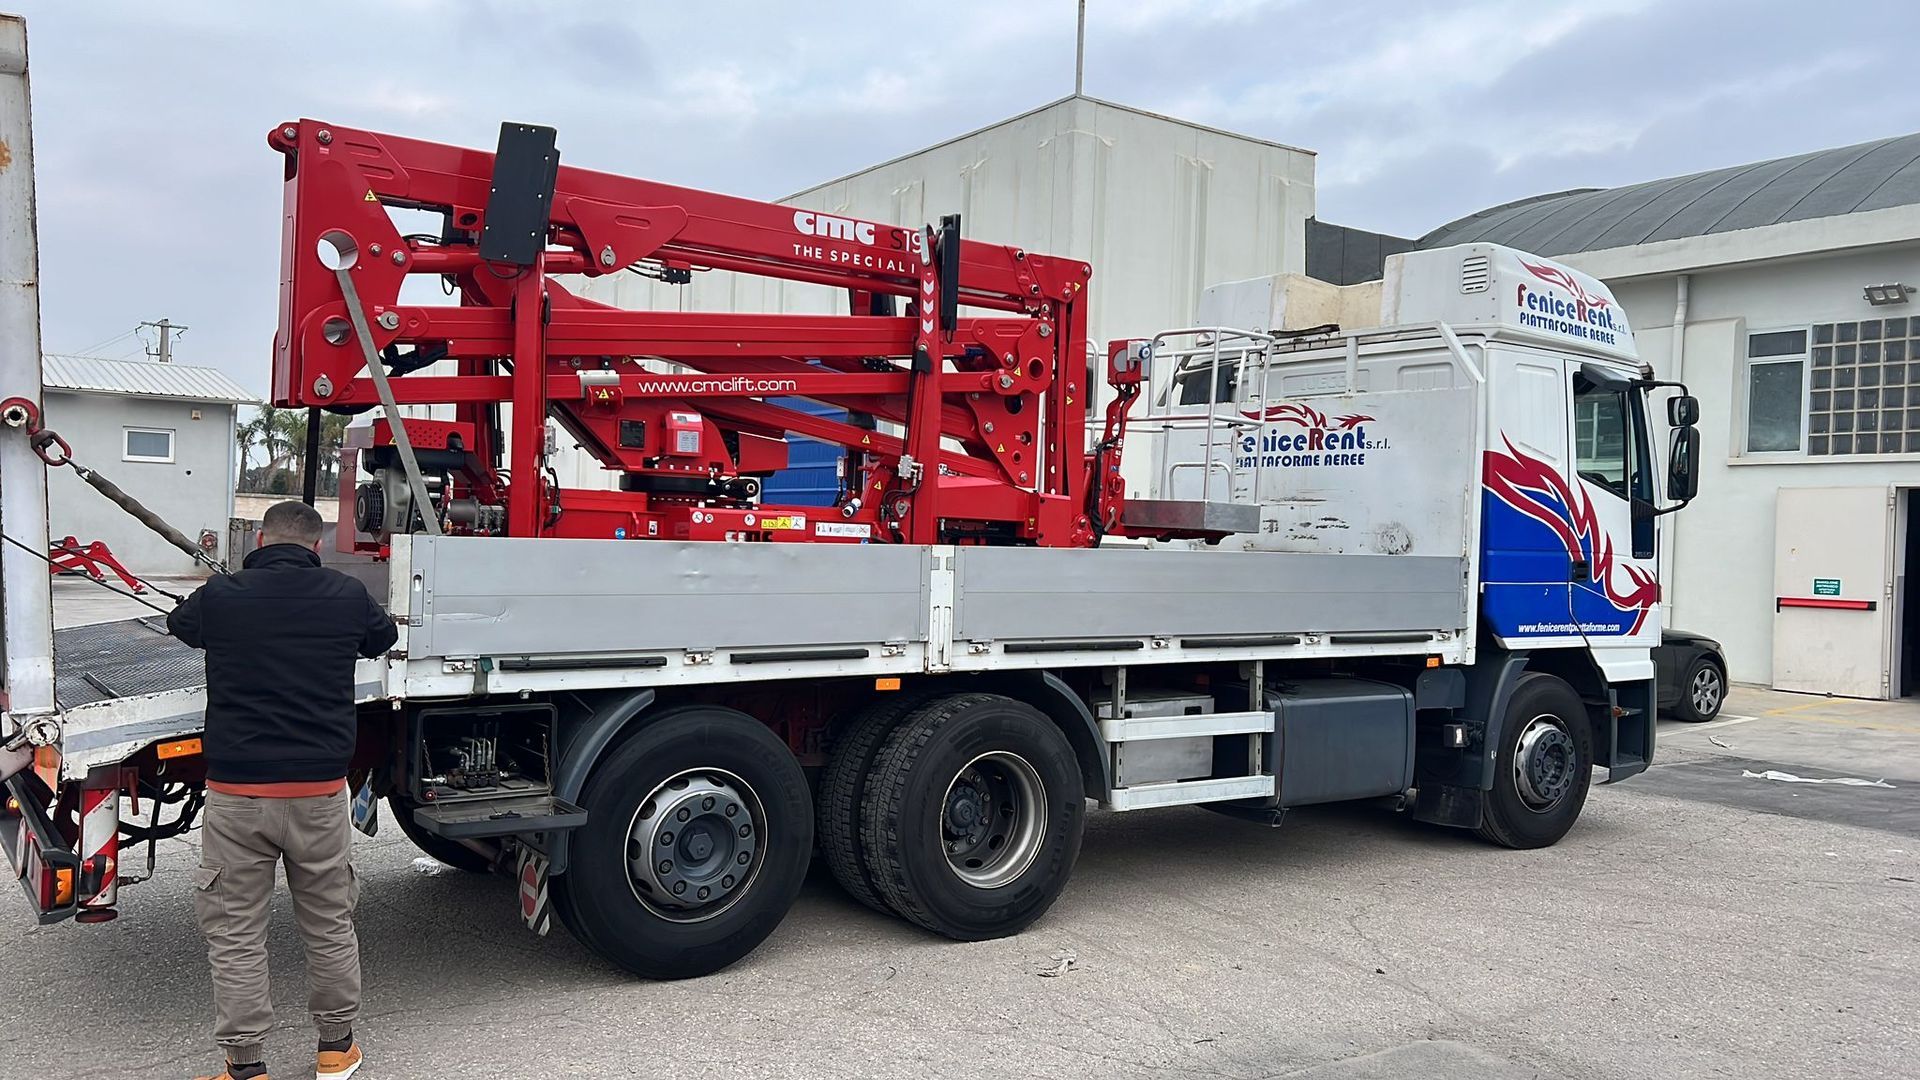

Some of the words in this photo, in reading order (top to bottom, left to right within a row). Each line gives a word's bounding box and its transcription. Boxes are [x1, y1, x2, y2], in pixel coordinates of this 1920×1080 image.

[794, 211, 875, 245] cmc
[793, 244, 822, 259] THE
[830, 250, 915, 274] SPECIALI
[1520, 311, 1587, 338] PIATTAFORME
[1590, 328, 1615, 345] AEREE
[638, 376, 797, 393] www.cmclift.com
[1236, 426, 1365, 453] eniceRent
[1366, 438, 1391, 450] s.r.l.
[1324, 453, 1365, 466] AEREE
